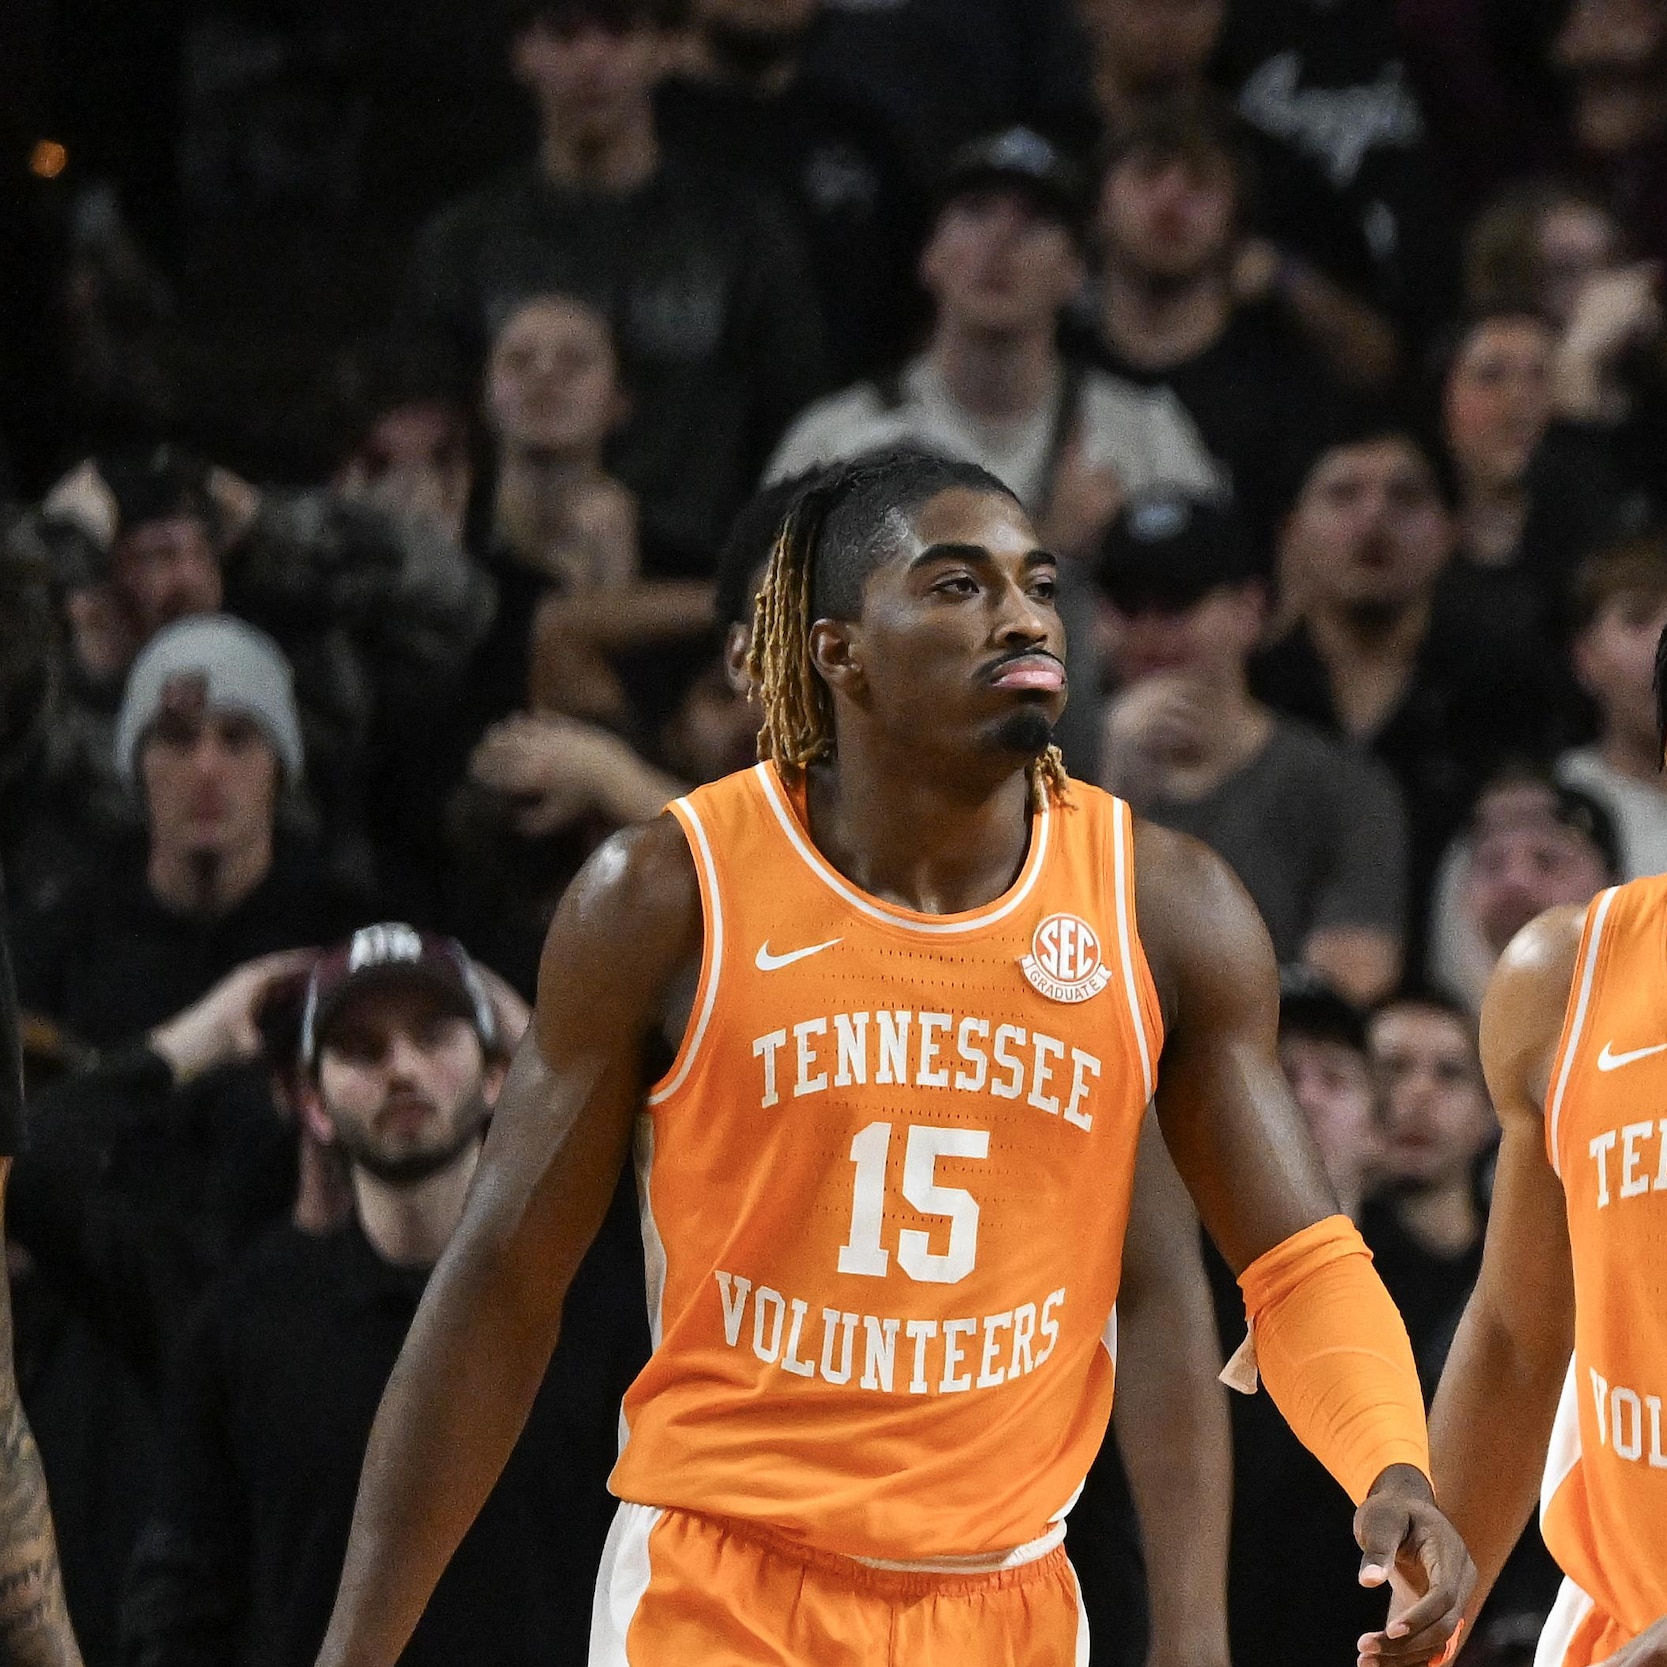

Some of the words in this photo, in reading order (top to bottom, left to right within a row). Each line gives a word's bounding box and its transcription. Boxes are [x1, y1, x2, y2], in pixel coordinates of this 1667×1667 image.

[1029, 969, 1101, 1001] GRADUATE
[1039, 918, 1095, 980] SEC
[752, 1010, 1101, 1132] TENNESSEE
[837, 1121, 989, 1285] 15
[714, 1270, 1066, 1395] VOLUNTEERS
